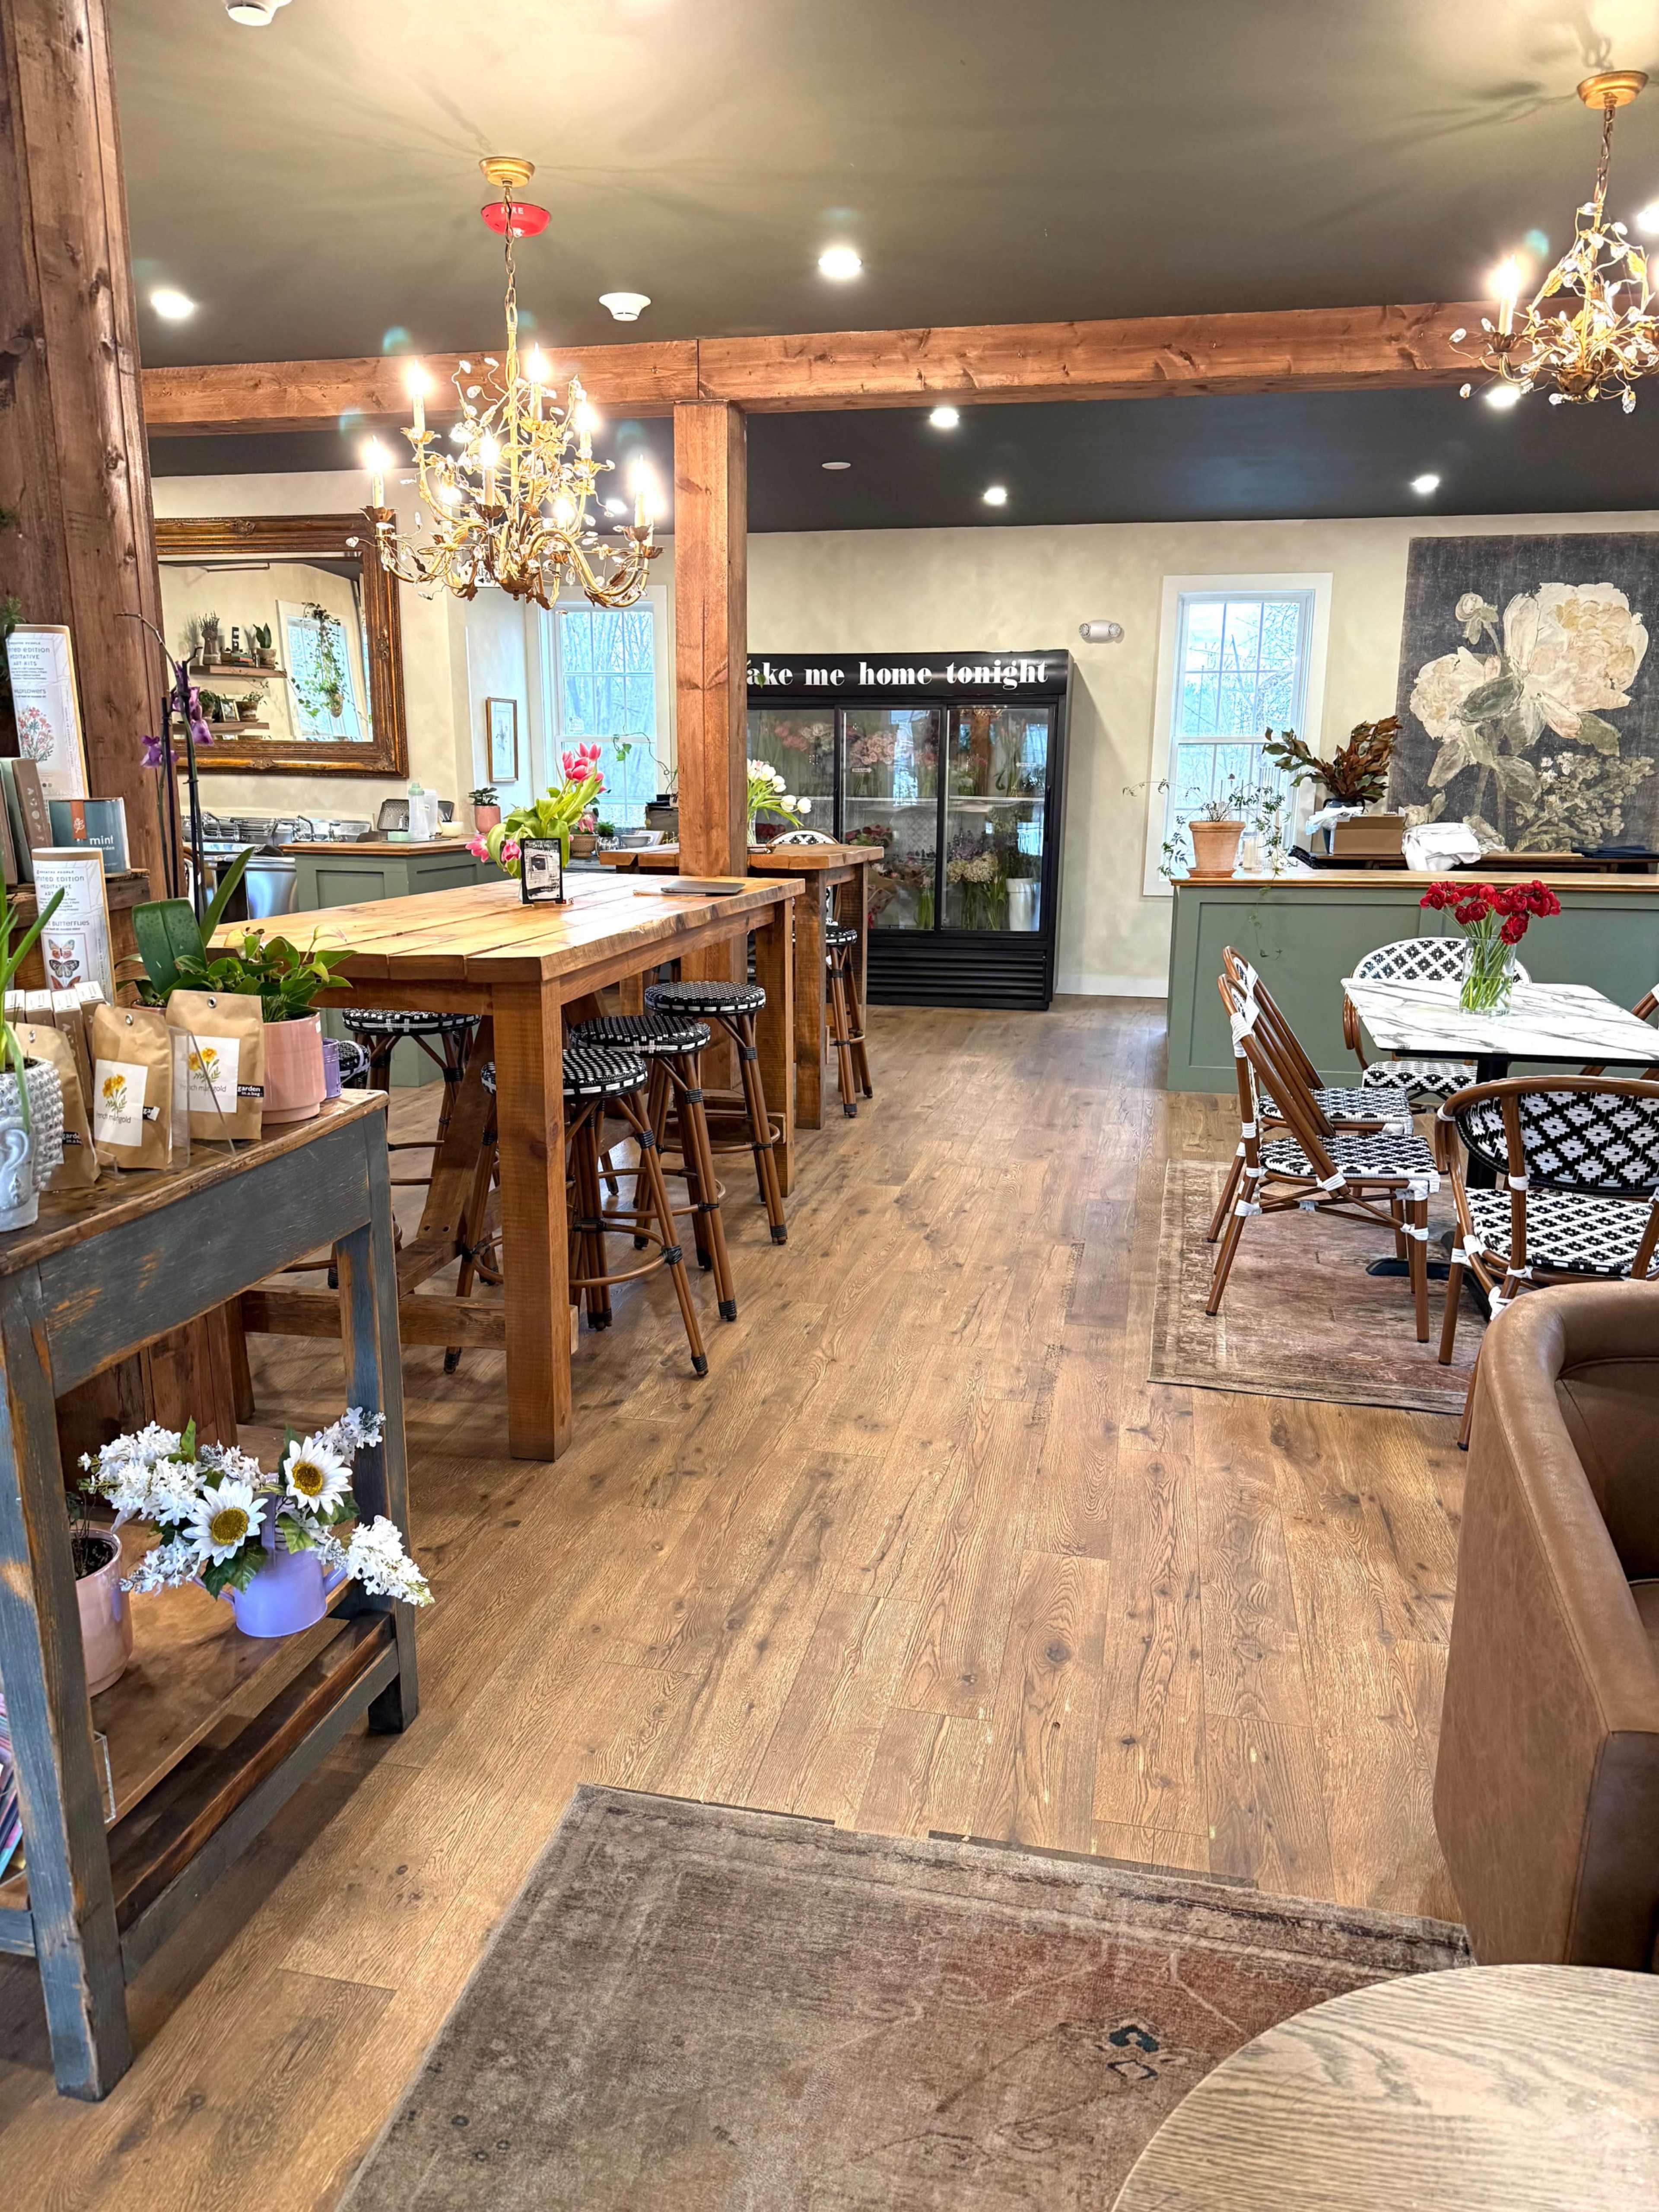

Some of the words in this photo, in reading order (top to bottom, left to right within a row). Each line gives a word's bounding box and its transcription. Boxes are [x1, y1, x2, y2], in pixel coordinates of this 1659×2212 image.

[747, 662, 793, 685] ake
[804, 668, 845, 686] me
[858, 662, 932, 685] home
[945, 659, 1049, 690] tonight
[90, 834, 114, 845] mint
